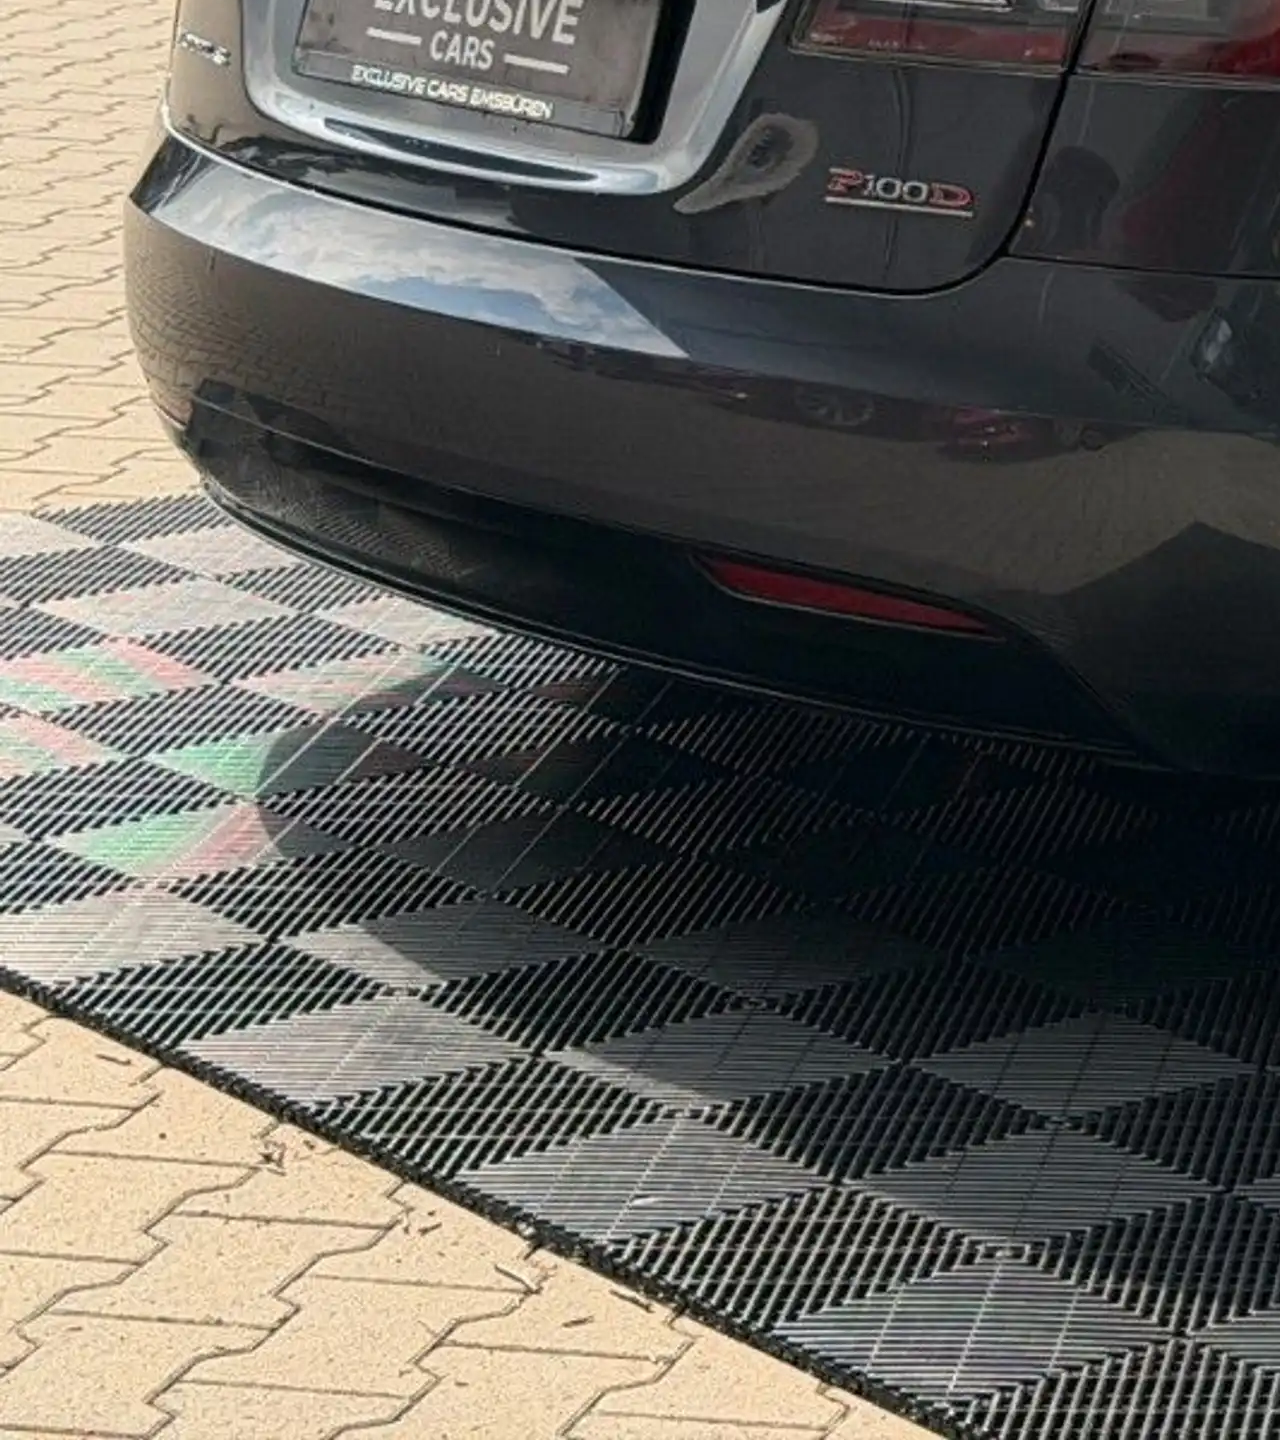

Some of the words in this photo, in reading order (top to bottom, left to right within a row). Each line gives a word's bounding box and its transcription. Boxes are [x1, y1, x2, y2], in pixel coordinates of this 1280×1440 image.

[430, 30, 495, 70] CARS
[352, 64, 426, 95] EXCLUSIVE
[427, 79, 469, 102] CARS
[826, 167, 974, 210] P100D
